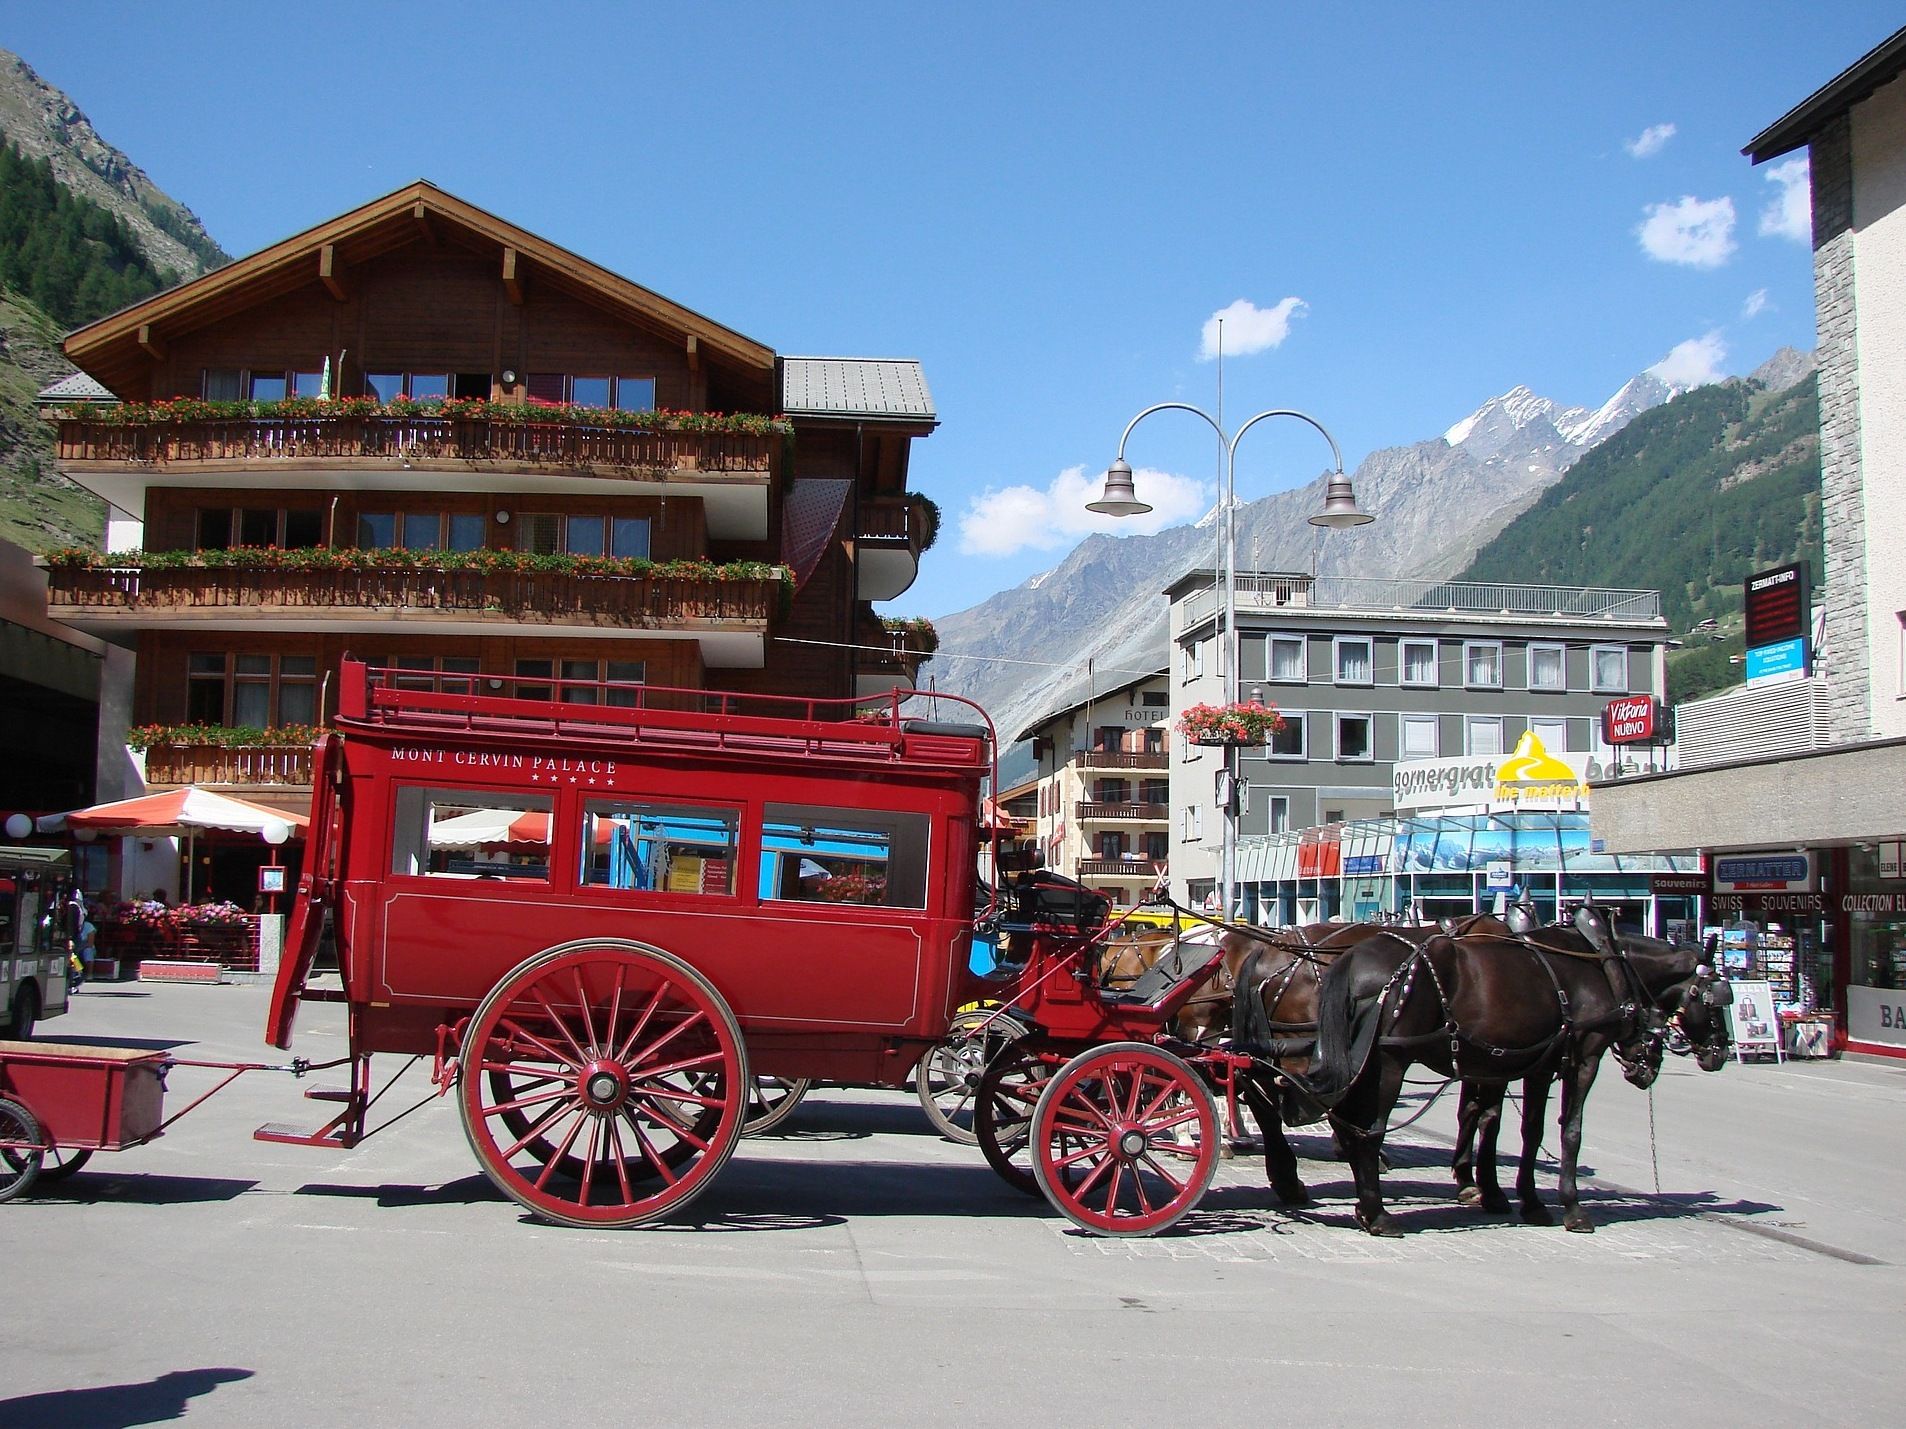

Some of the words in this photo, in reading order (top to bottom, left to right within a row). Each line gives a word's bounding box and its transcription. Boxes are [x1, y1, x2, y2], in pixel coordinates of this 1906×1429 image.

[1750, 570, 1795, 591] ZERMATT-INFO
[1610, 699, 1649, 724] Viktoria
[391, 747, 446, 763] MONT
[455, 751, 523, 768] CERVIN
[532, 756, 616, 774] PALACE
[1394, 762, 1494, 794] gornergrat
[1719, 860, 1802, 879] ZERMATTER
[1653, 878, 1707, 889] souvenirs
[1712, 895, 1743, 911] SWISS
[1761, 894, 1822, 911] SOUVENIRS
[1842, 894, 1892, 912] COLLECTION
